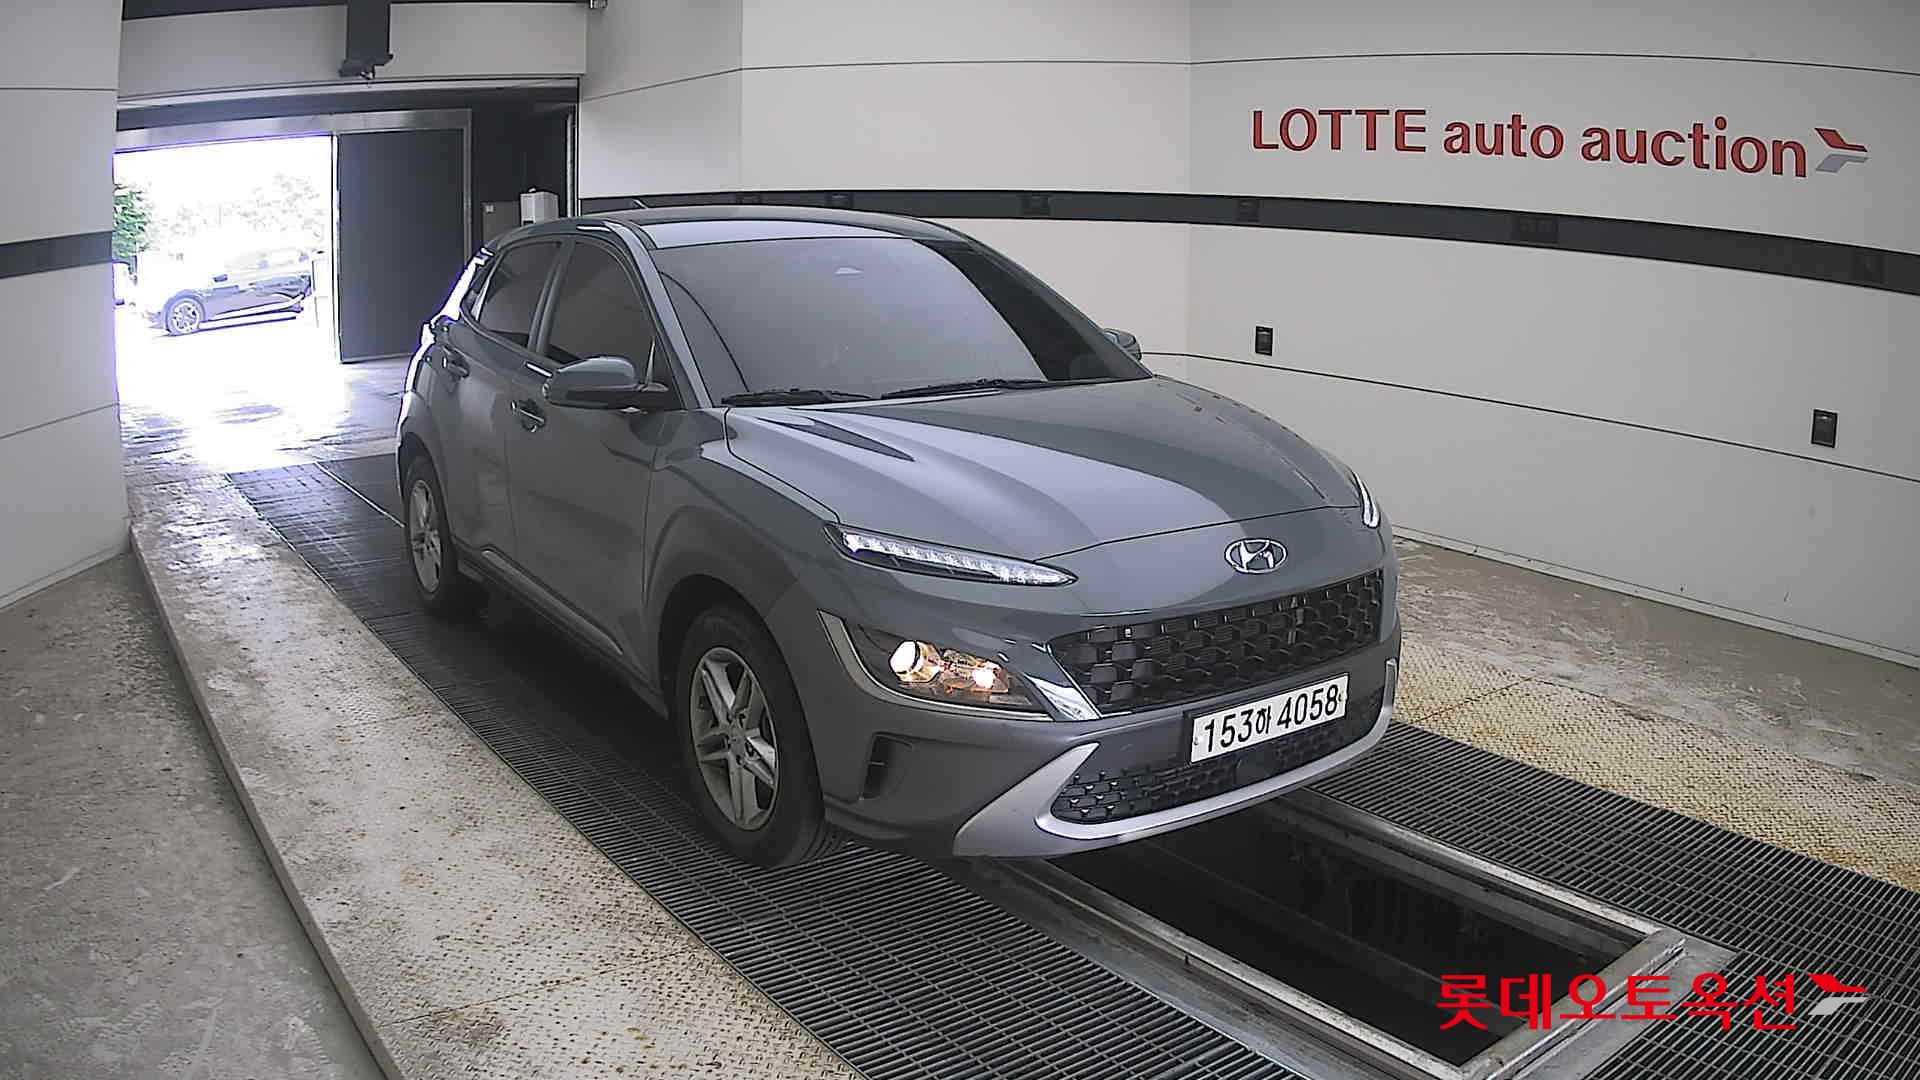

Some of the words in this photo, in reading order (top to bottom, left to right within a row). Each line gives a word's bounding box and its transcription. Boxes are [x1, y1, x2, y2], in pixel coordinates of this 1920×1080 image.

[1252, 108, 1427, 153] LOTTE
[1443, 113, 1565, 160] auto
[1580, 115, 1808, 178] auction
[1204, 705, 1272, 752] 153하
[1277, 684, 1339, 729] 4058
